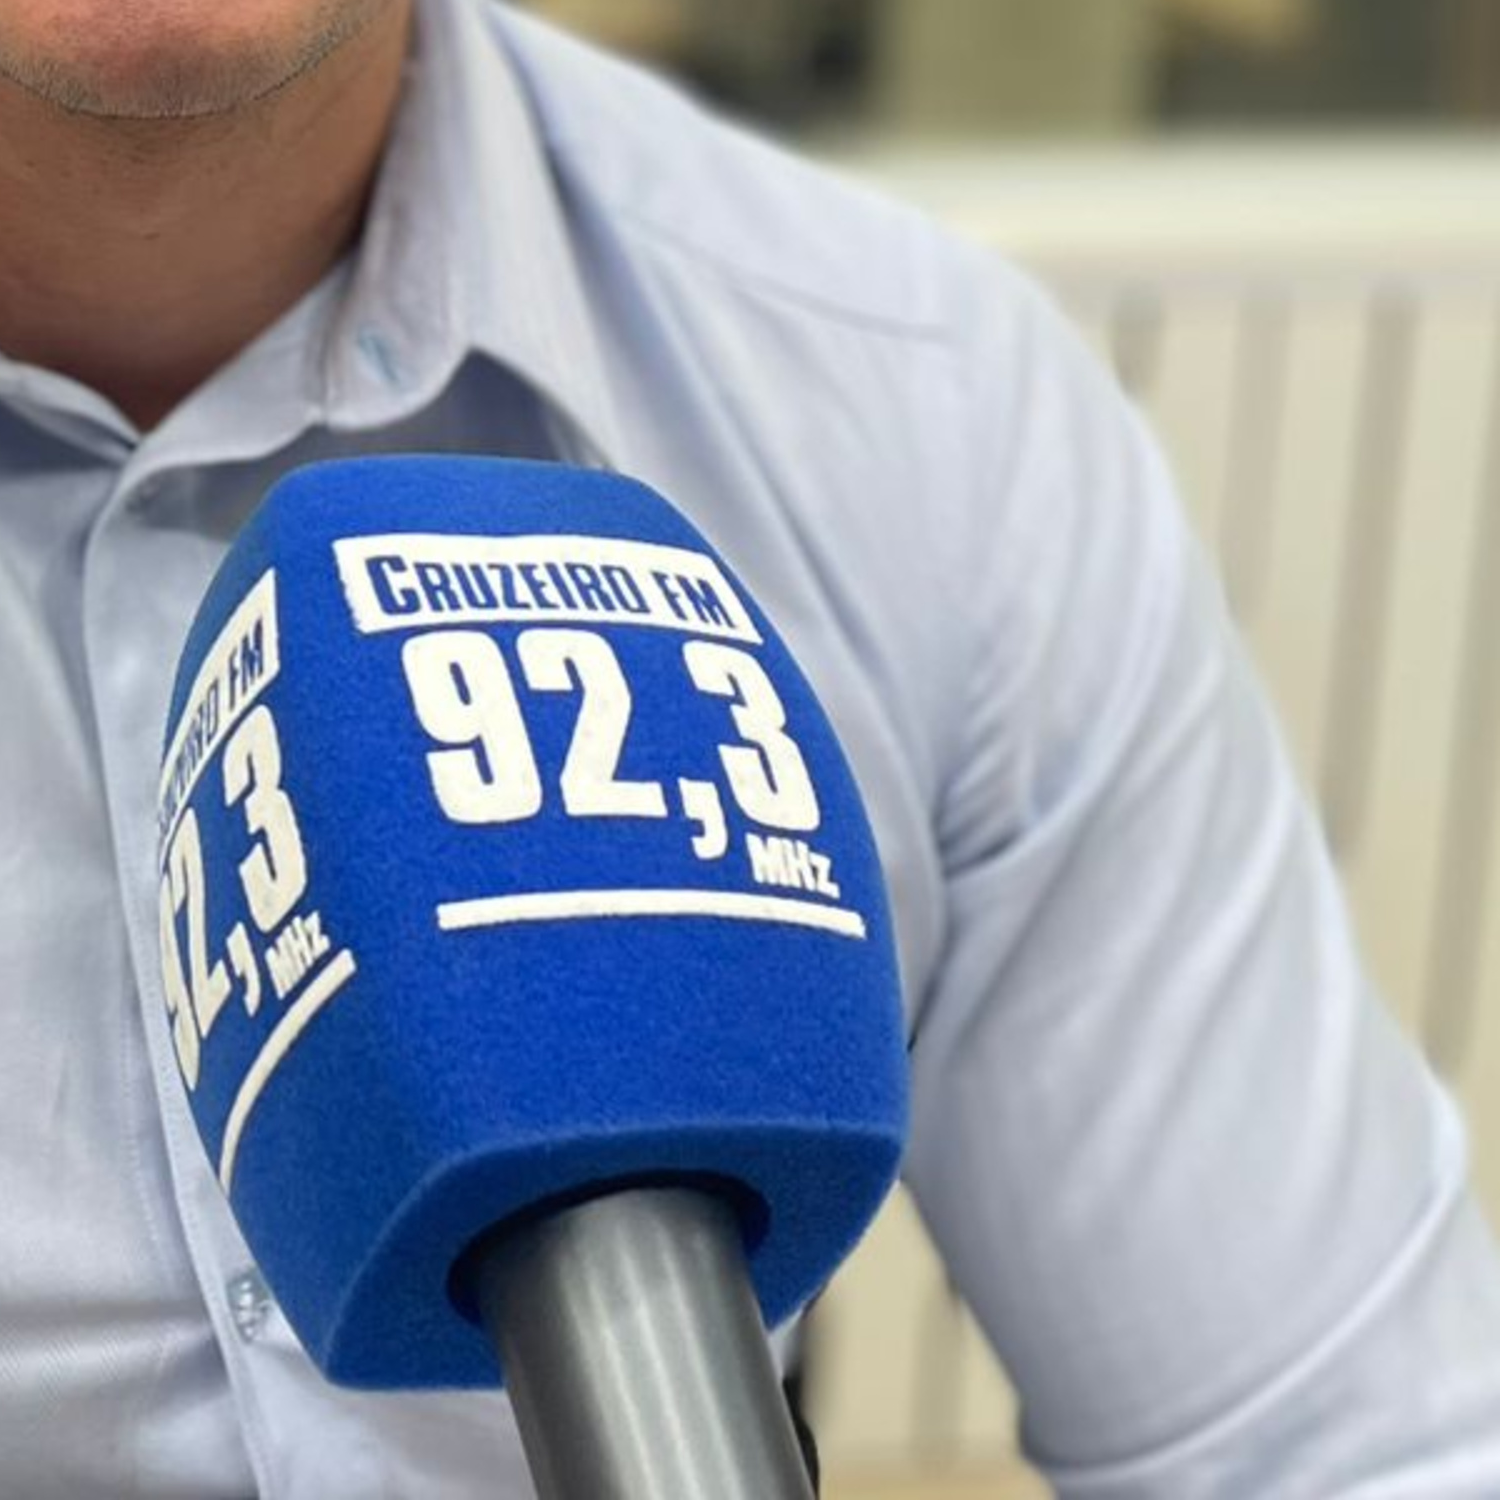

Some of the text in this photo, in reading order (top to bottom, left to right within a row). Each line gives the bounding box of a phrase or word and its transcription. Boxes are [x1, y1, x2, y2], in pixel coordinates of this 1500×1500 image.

[365, 554, 736, 629] CRUZEIRO FM
[228, 617, 264, 713] FM
[402, 628, 821, 861] 92,3
[744, 831, 841, 900] MHz
